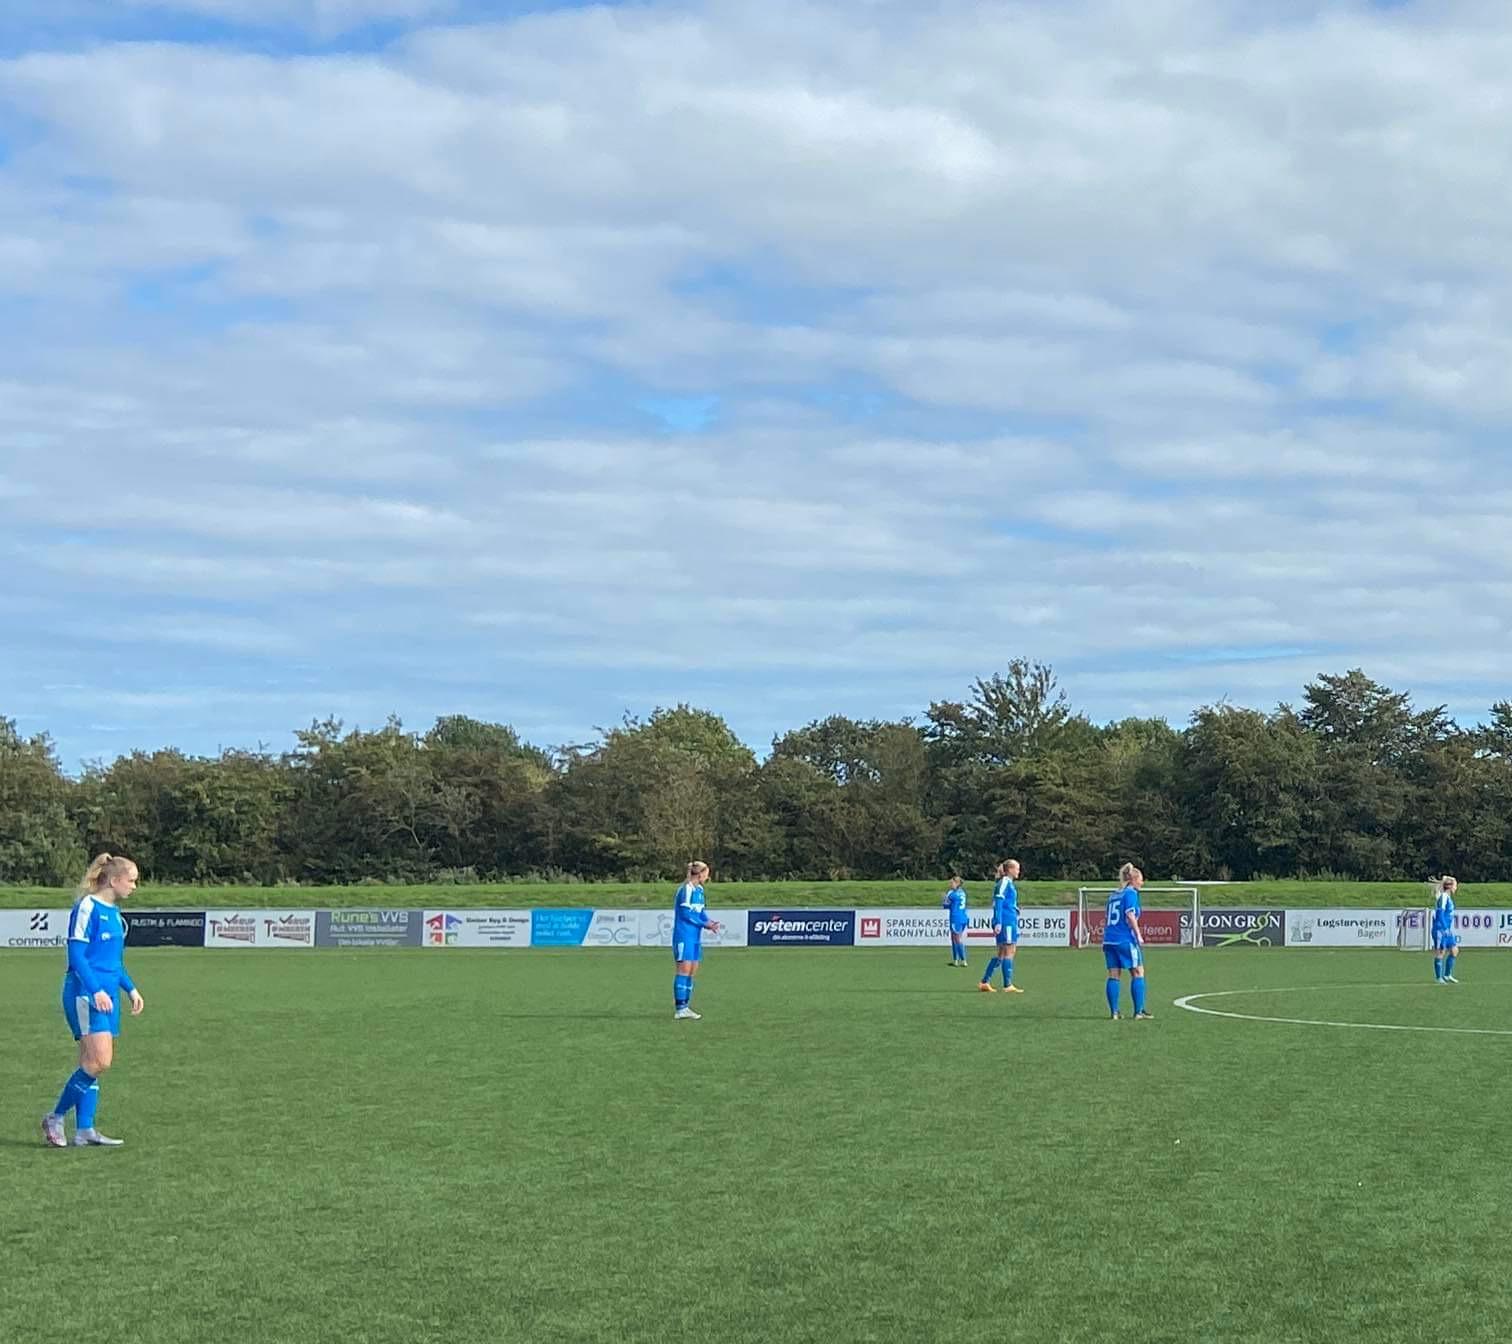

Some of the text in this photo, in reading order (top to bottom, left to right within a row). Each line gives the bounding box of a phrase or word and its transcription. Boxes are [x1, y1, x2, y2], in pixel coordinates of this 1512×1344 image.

[381, 912, 409, 923] VVS
[1107, 901, 1121, 926] 15
[754, 919, 849, 934] systemcenter
[886, 919, 950, 928] SPAREKASSE
[967, 918, 1066, 929] LUN OSE BYG
[886, 929, 950, 937] KRONJYLLAN
